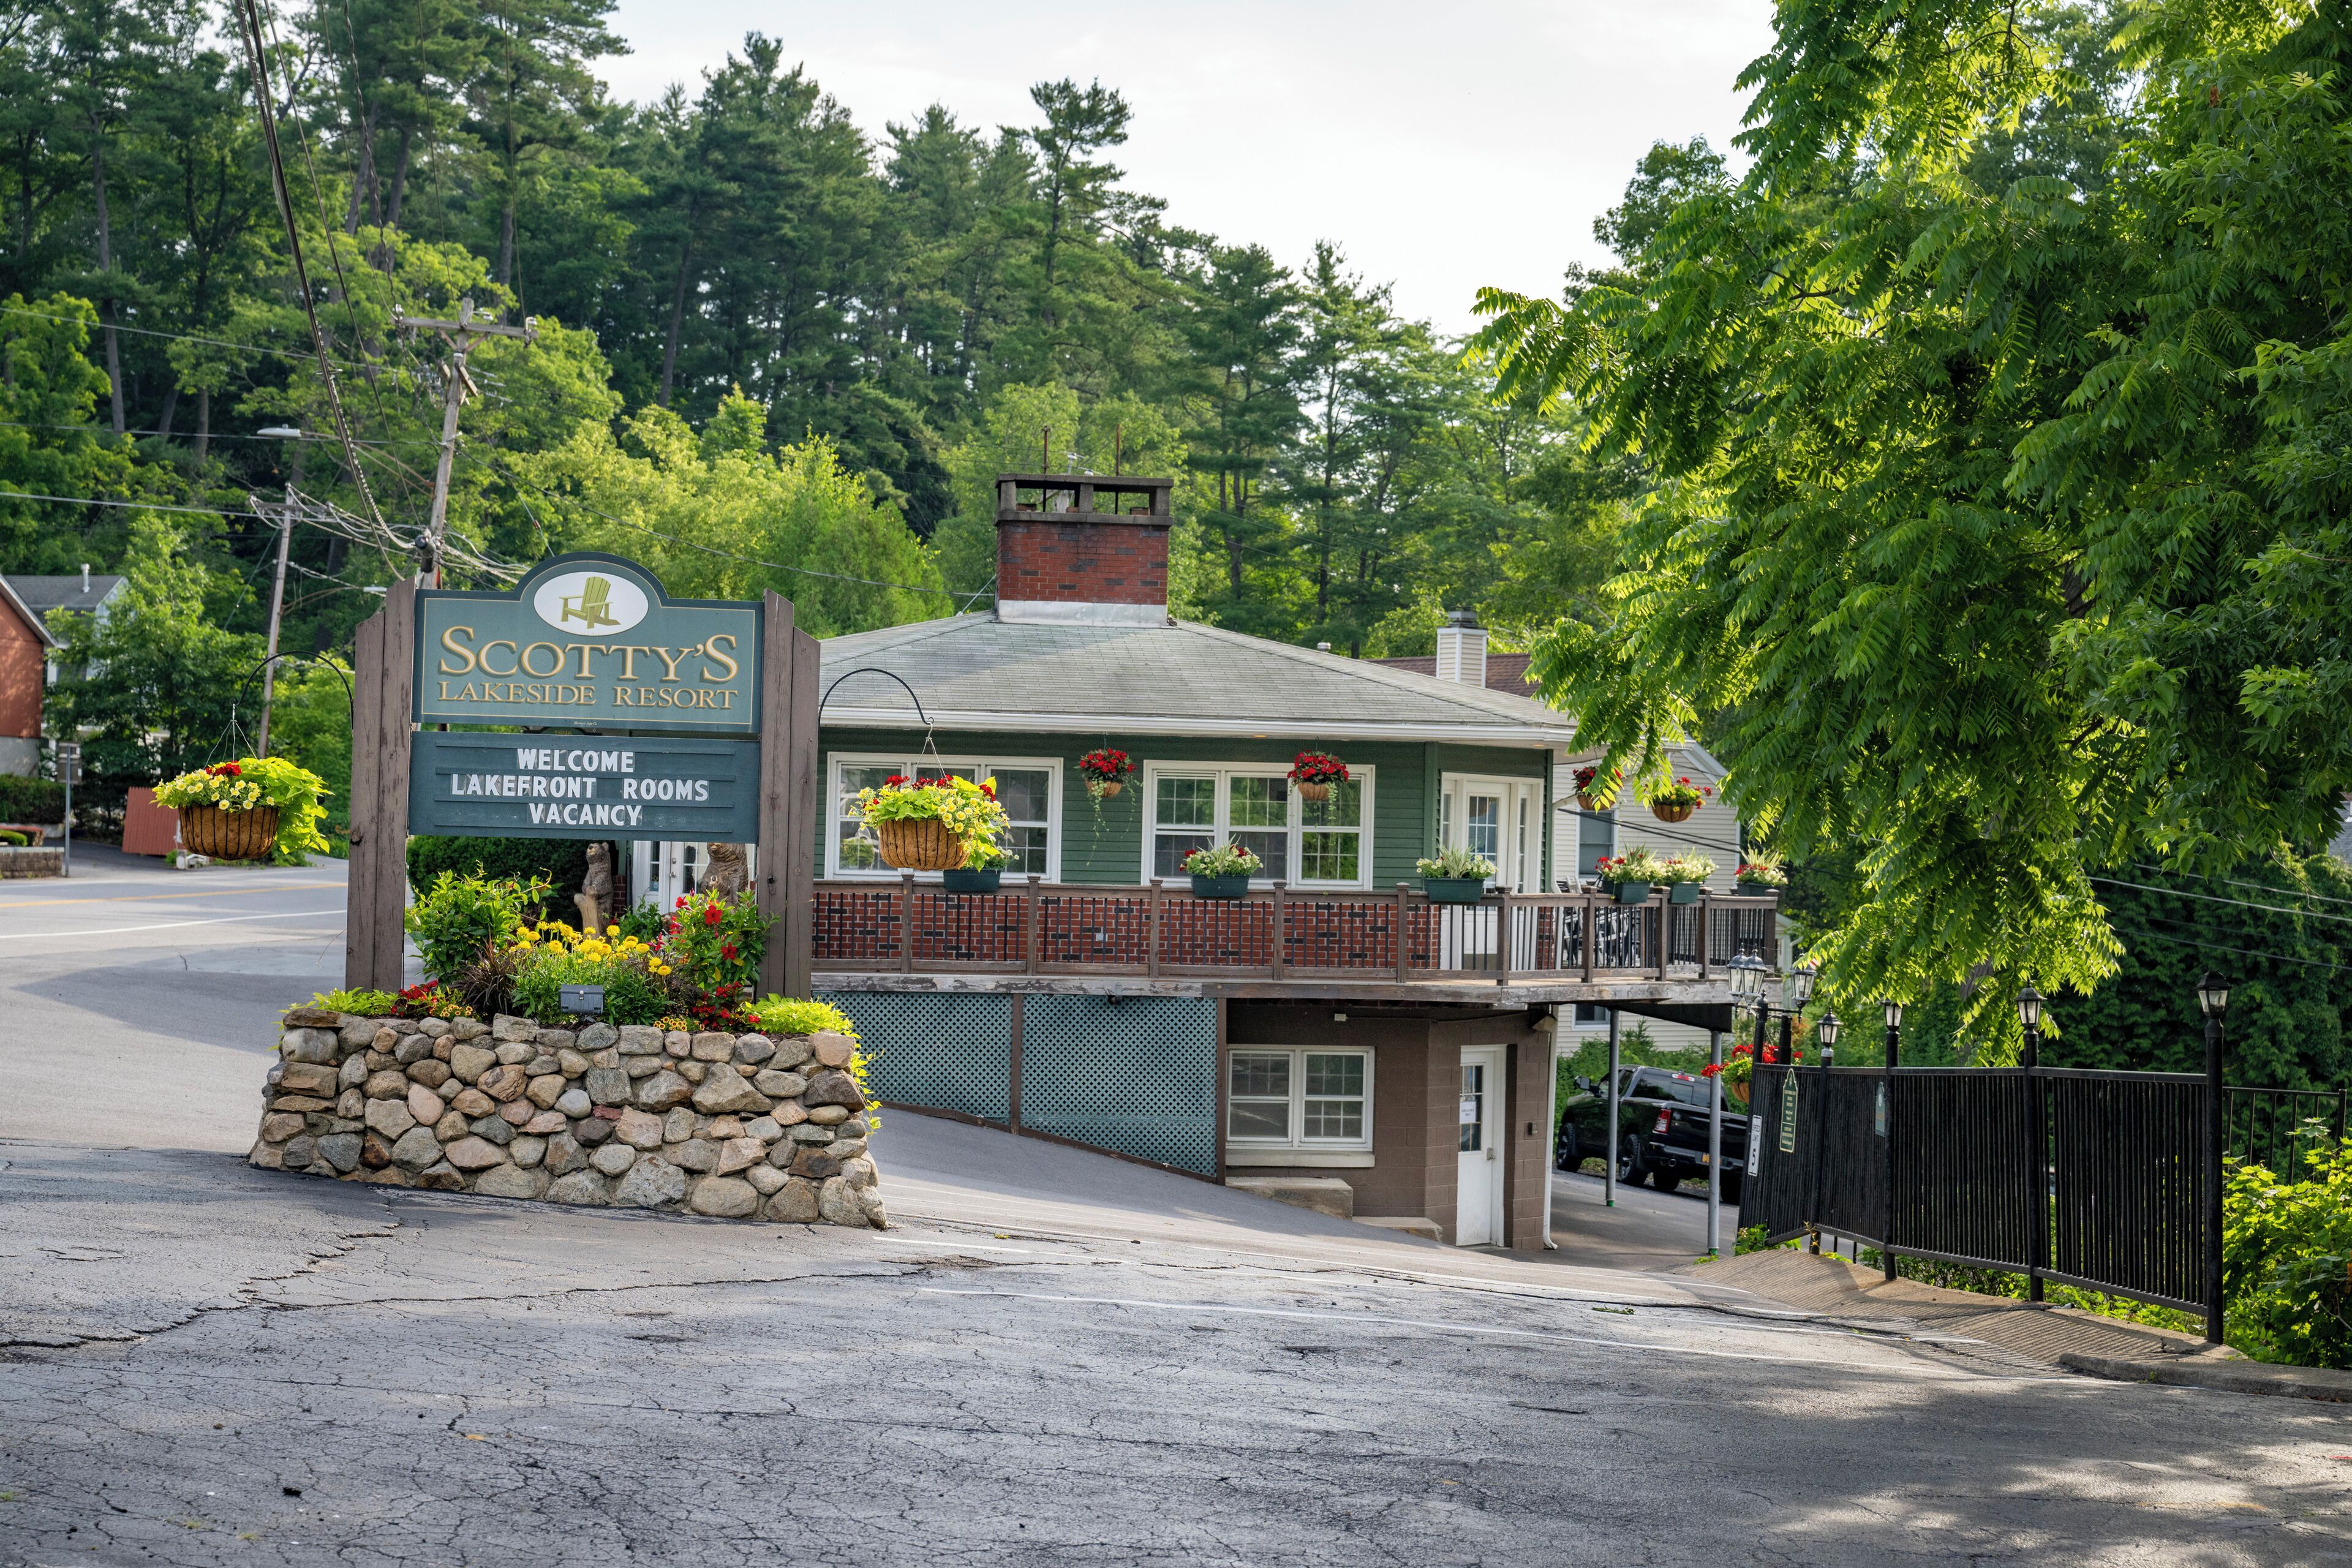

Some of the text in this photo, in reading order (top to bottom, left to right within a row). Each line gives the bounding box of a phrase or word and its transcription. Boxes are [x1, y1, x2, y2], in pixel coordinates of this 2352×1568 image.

[439, 626, 739, 682] SCOTTY'S
[438, 681, 738, 709] LAKESIDE RESORT
[518, 748, 635, 772] WELCOME
[451, 774, 709, 801] LAKEFRONT ROOMS
[529, 804, 643, 826] VACANCY
[1752, 1148, 1756, 1166] 5
